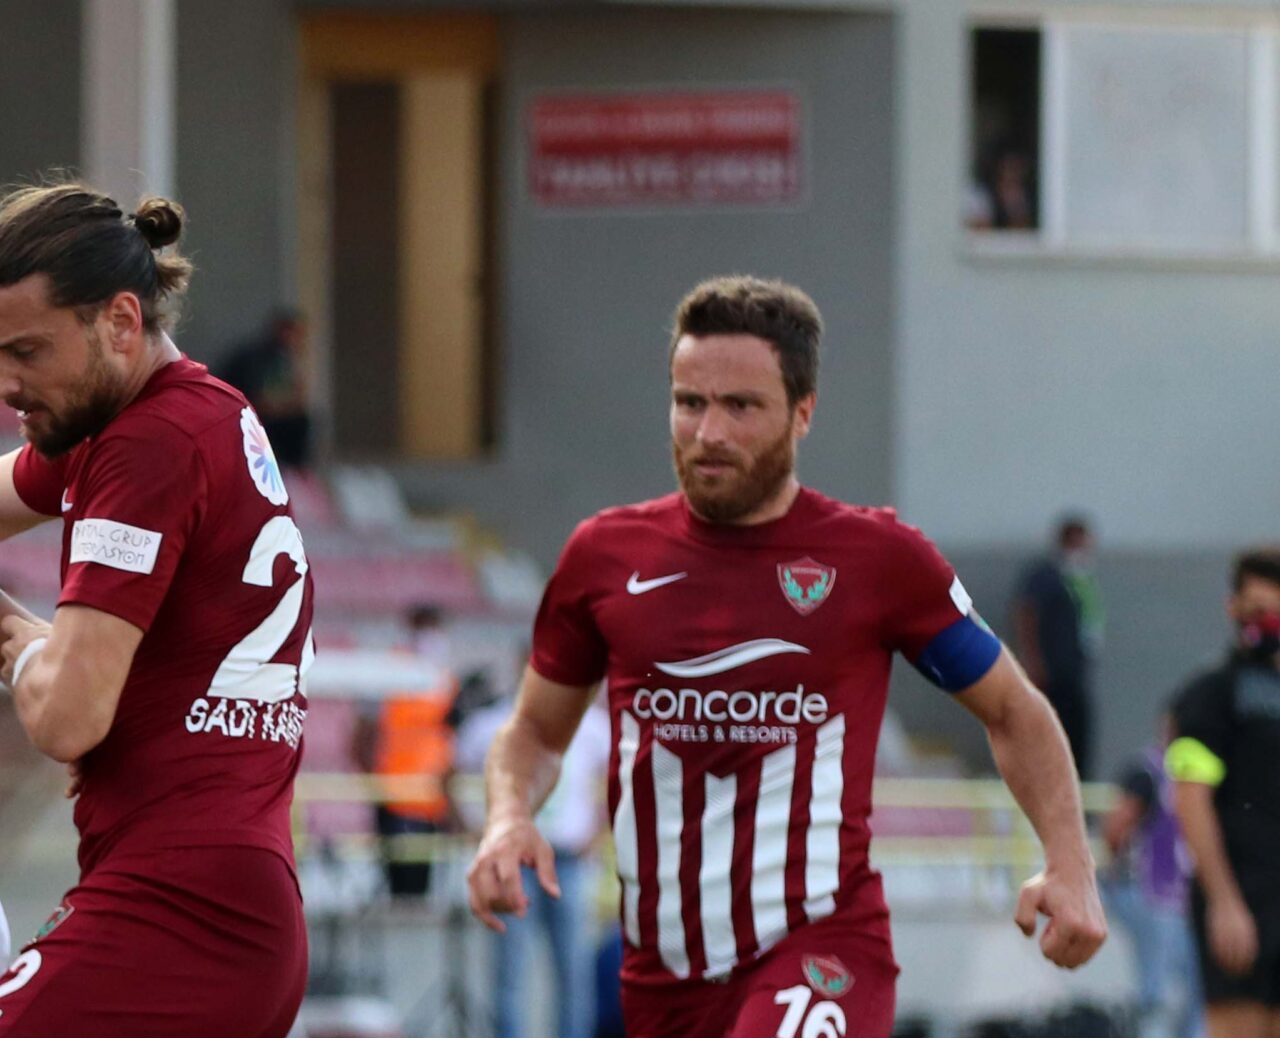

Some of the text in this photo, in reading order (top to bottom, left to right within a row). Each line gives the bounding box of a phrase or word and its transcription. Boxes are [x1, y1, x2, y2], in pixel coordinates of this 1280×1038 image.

[109, 528, 152, 549] GRUP
[632, 683, 829, 725] concorde
[654, 723, 798, 744] HOTELS & RESORTS
